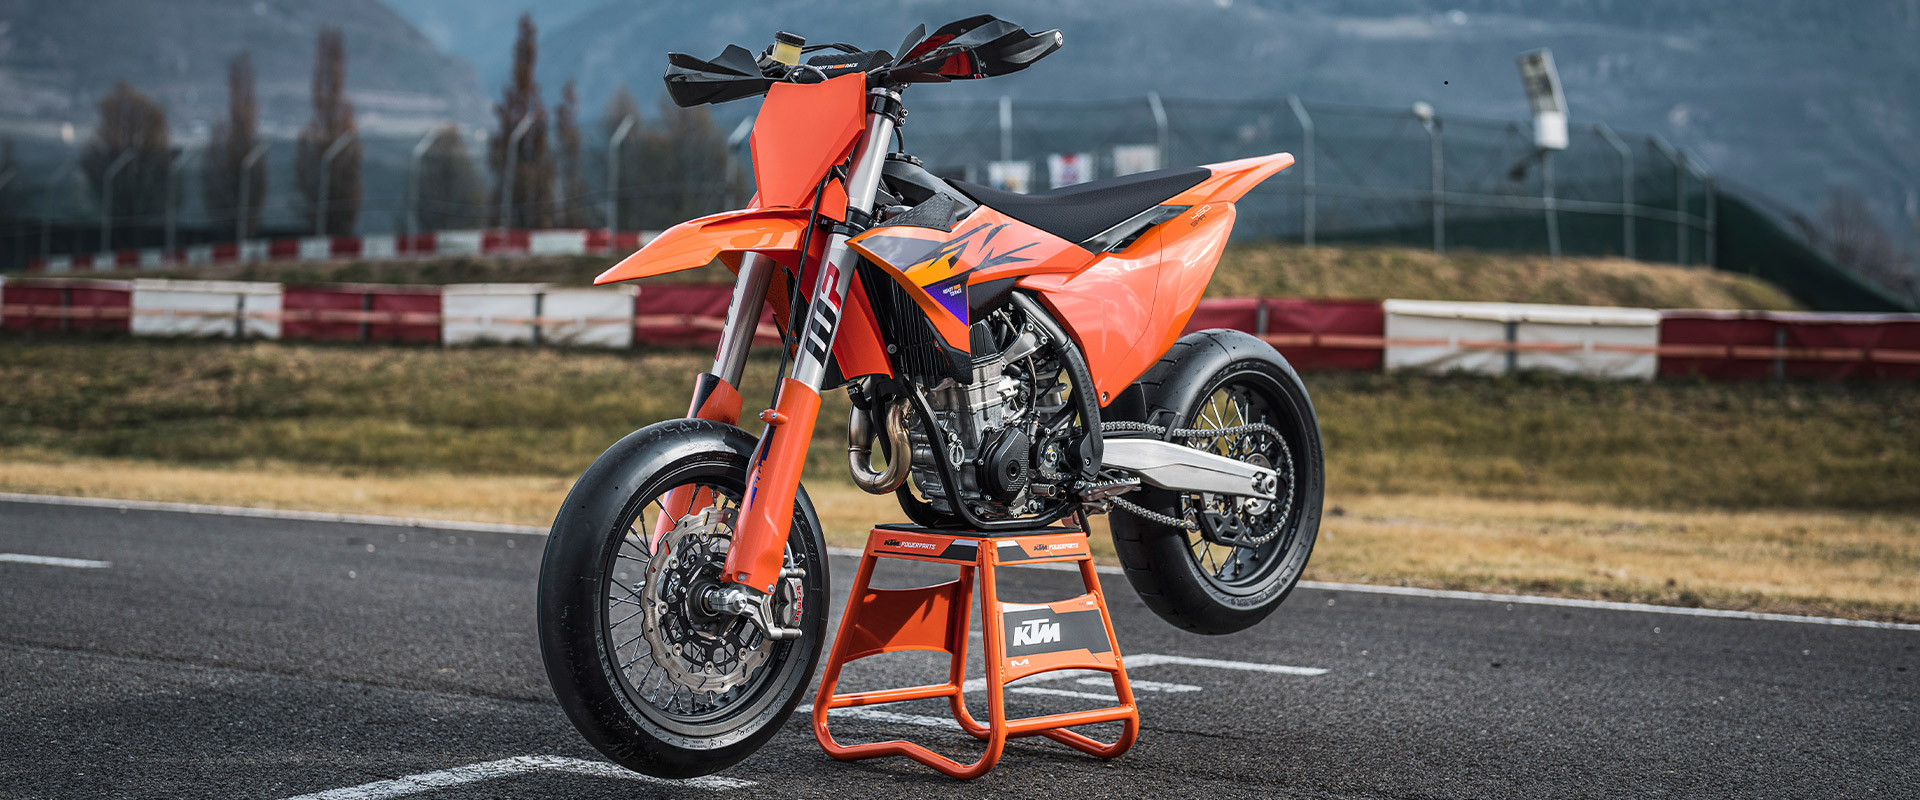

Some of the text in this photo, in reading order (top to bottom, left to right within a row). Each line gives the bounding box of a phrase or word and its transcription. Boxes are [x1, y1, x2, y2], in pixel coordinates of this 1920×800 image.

[1190, 204, 1211, 219] 450
[806, 261, 842, 368] WP
[901, 541, 936, 550] POWERPARTS
[1048, 542, 1079, 550] POWERPARTS
[794, 585, 802, 622] brembo
[1013, 618, 1061, 647] KTM
